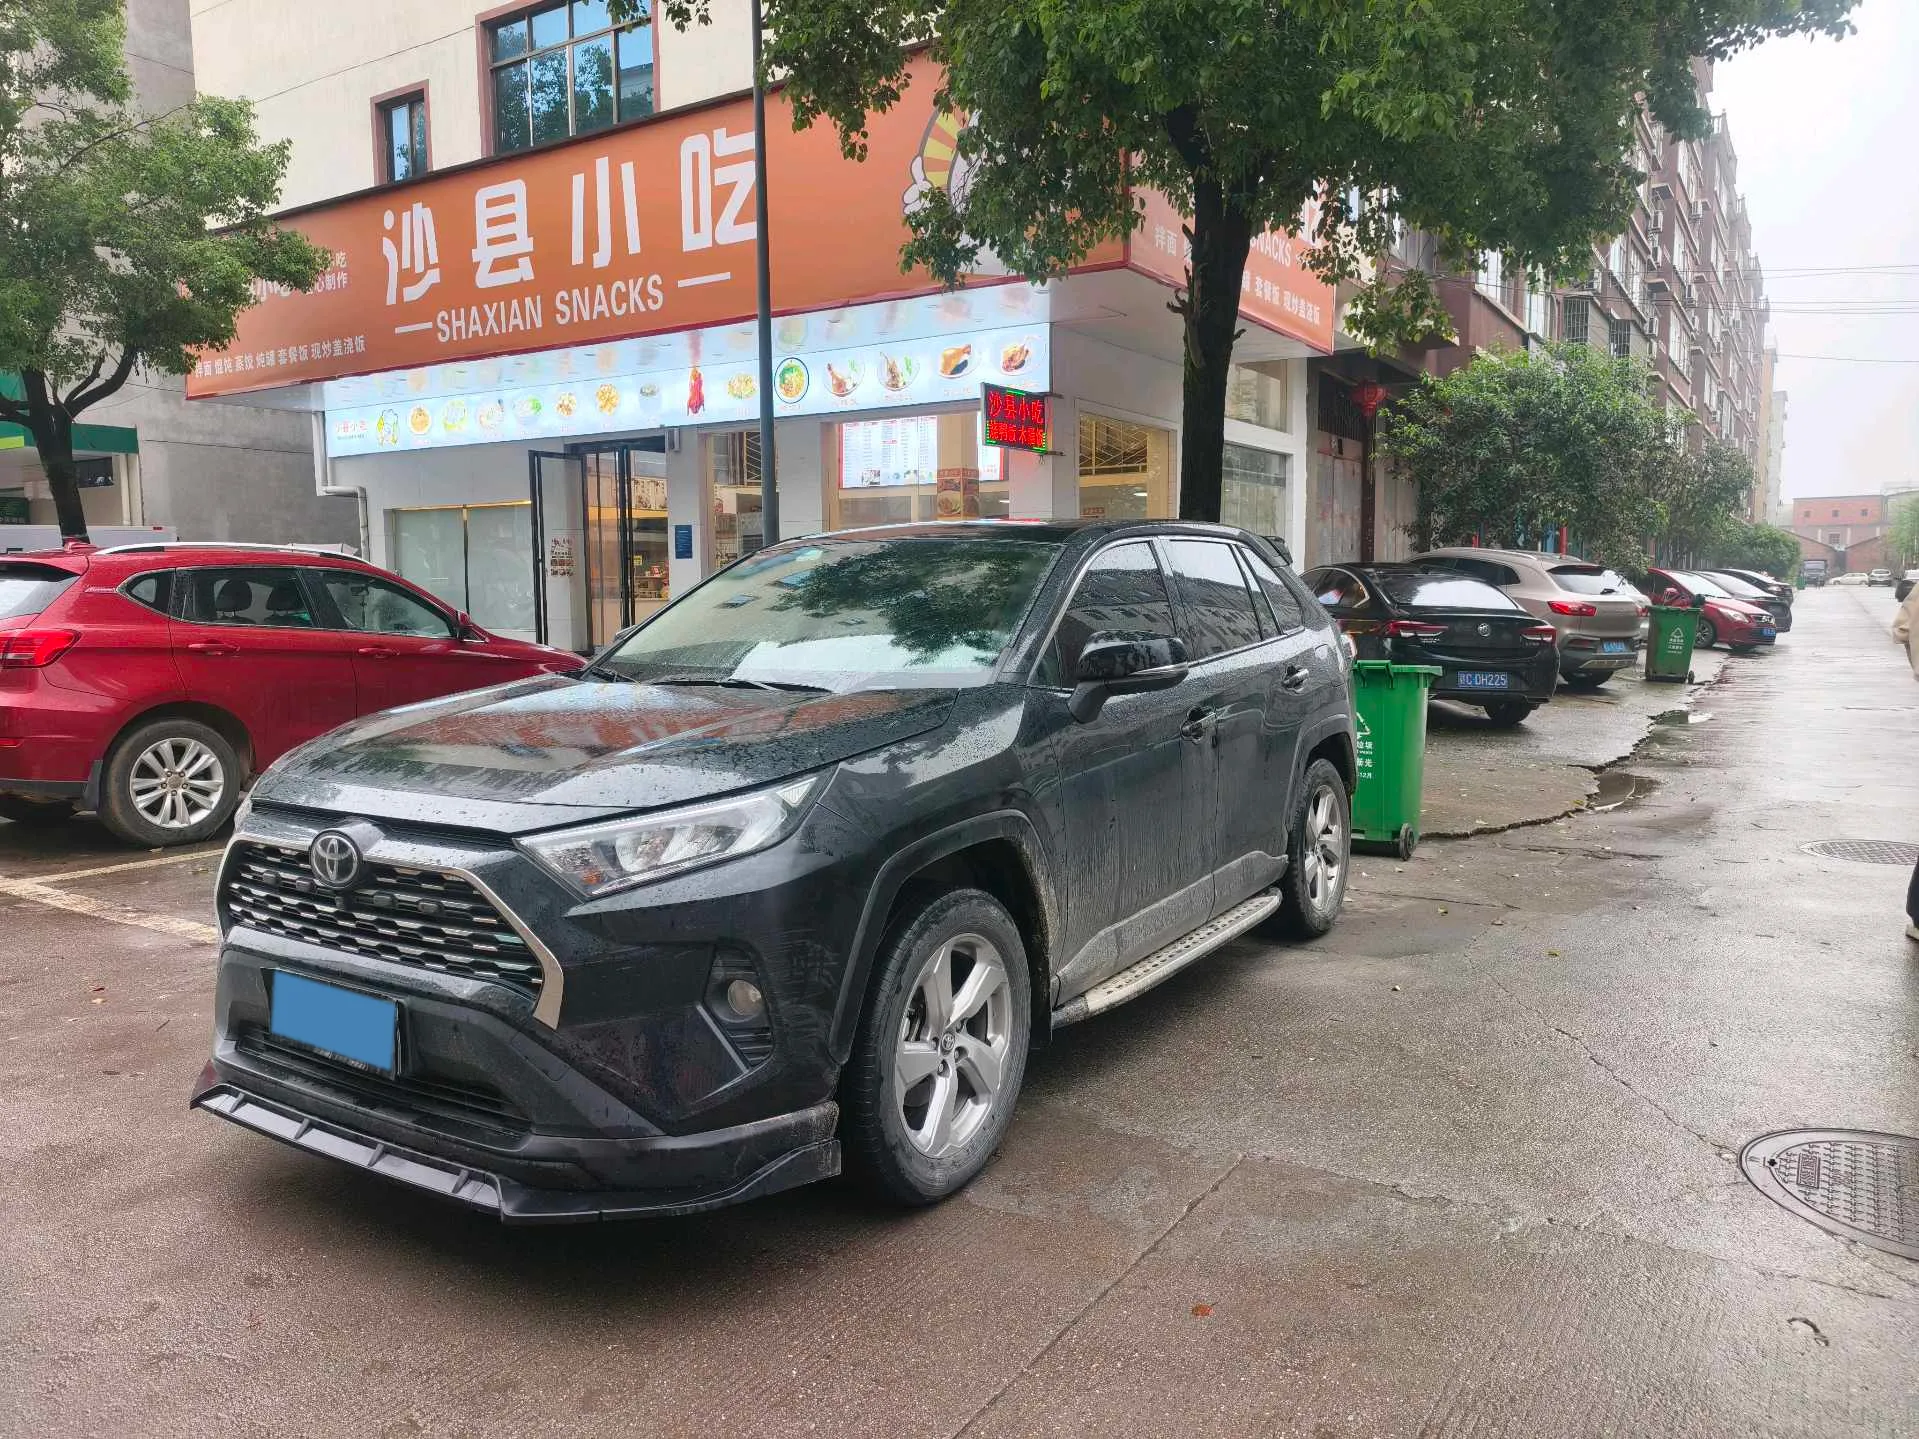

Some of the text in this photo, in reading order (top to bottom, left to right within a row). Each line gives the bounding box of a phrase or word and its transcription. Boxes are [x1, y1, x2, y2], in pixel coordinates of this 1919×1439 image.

[381, 127, 757, 305] 沙县小吃
[436, 274, 664, 343] SHAXIAN SNACKS
[988, 391, 1045, 424] 沙县小吃
